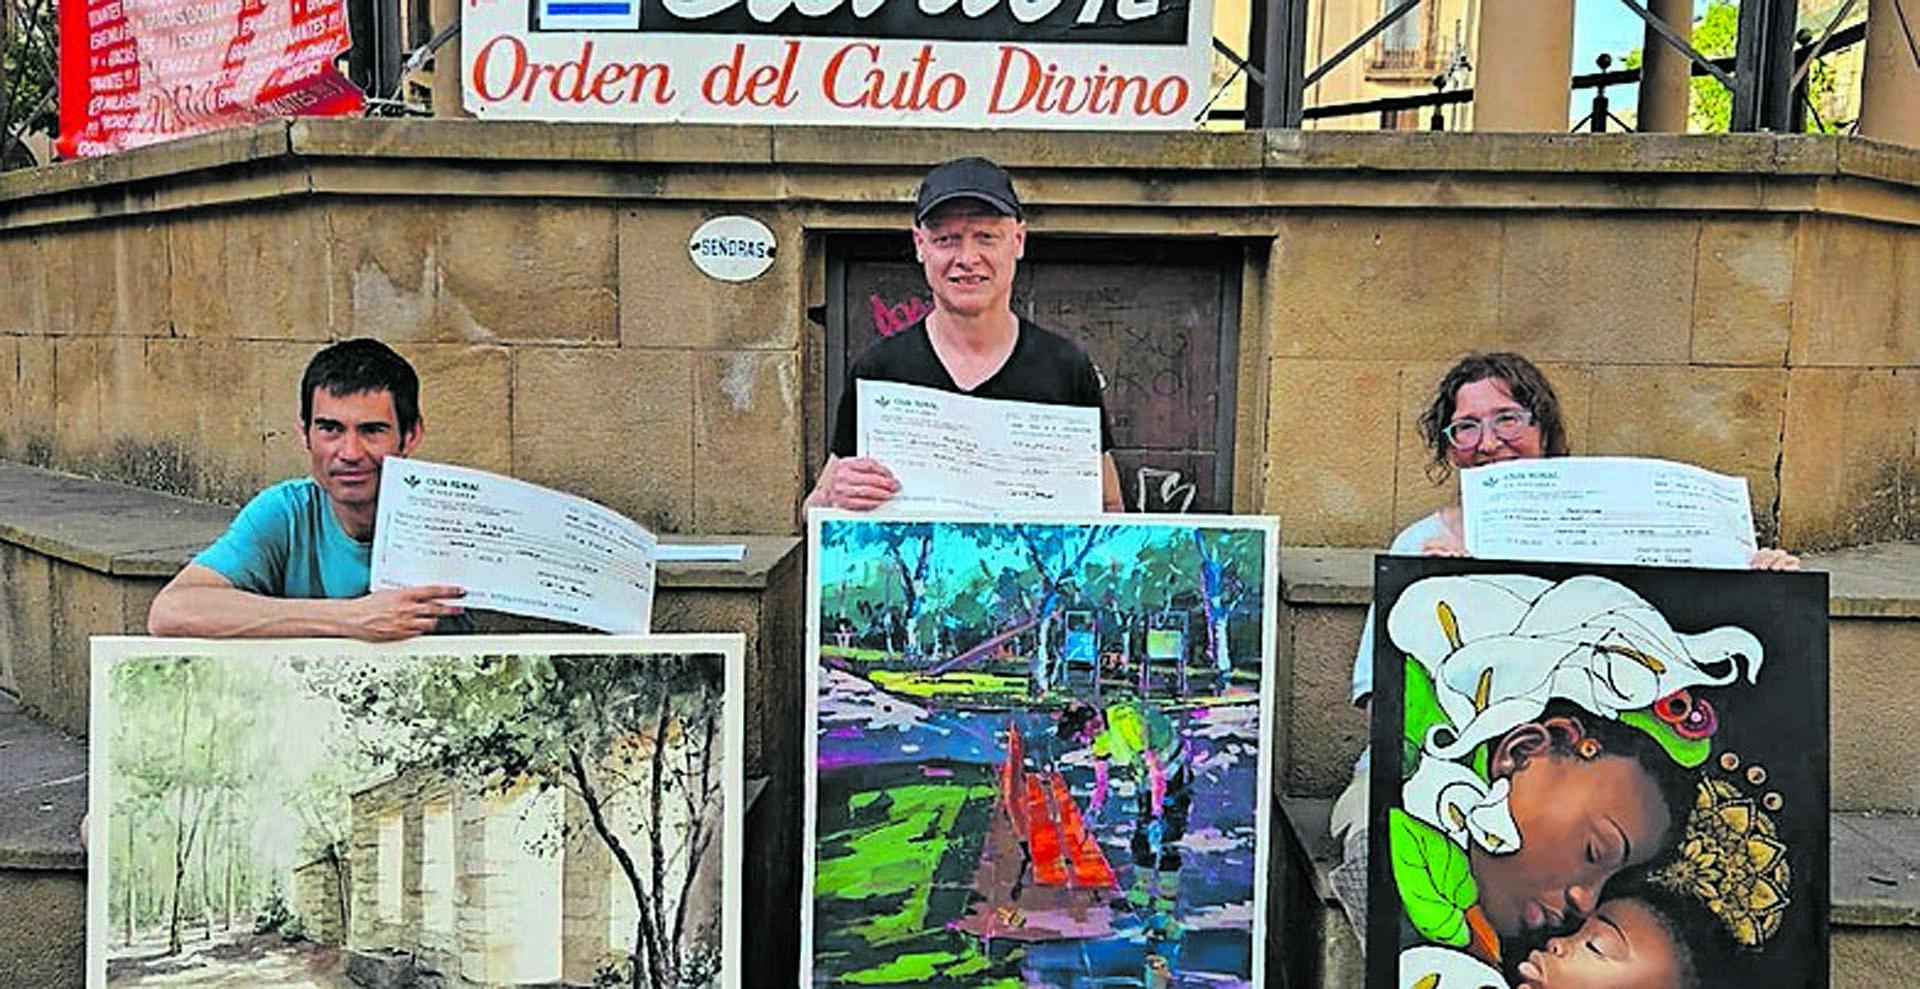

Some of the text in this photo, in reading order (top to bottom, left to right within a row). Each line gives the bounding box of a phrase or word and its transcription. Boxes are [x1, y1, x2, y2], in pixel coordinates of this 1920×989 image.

[473, 35, 1189, 117] Orden del Cuto Divino
[701, 237, 765, 258] SEÑORAS
